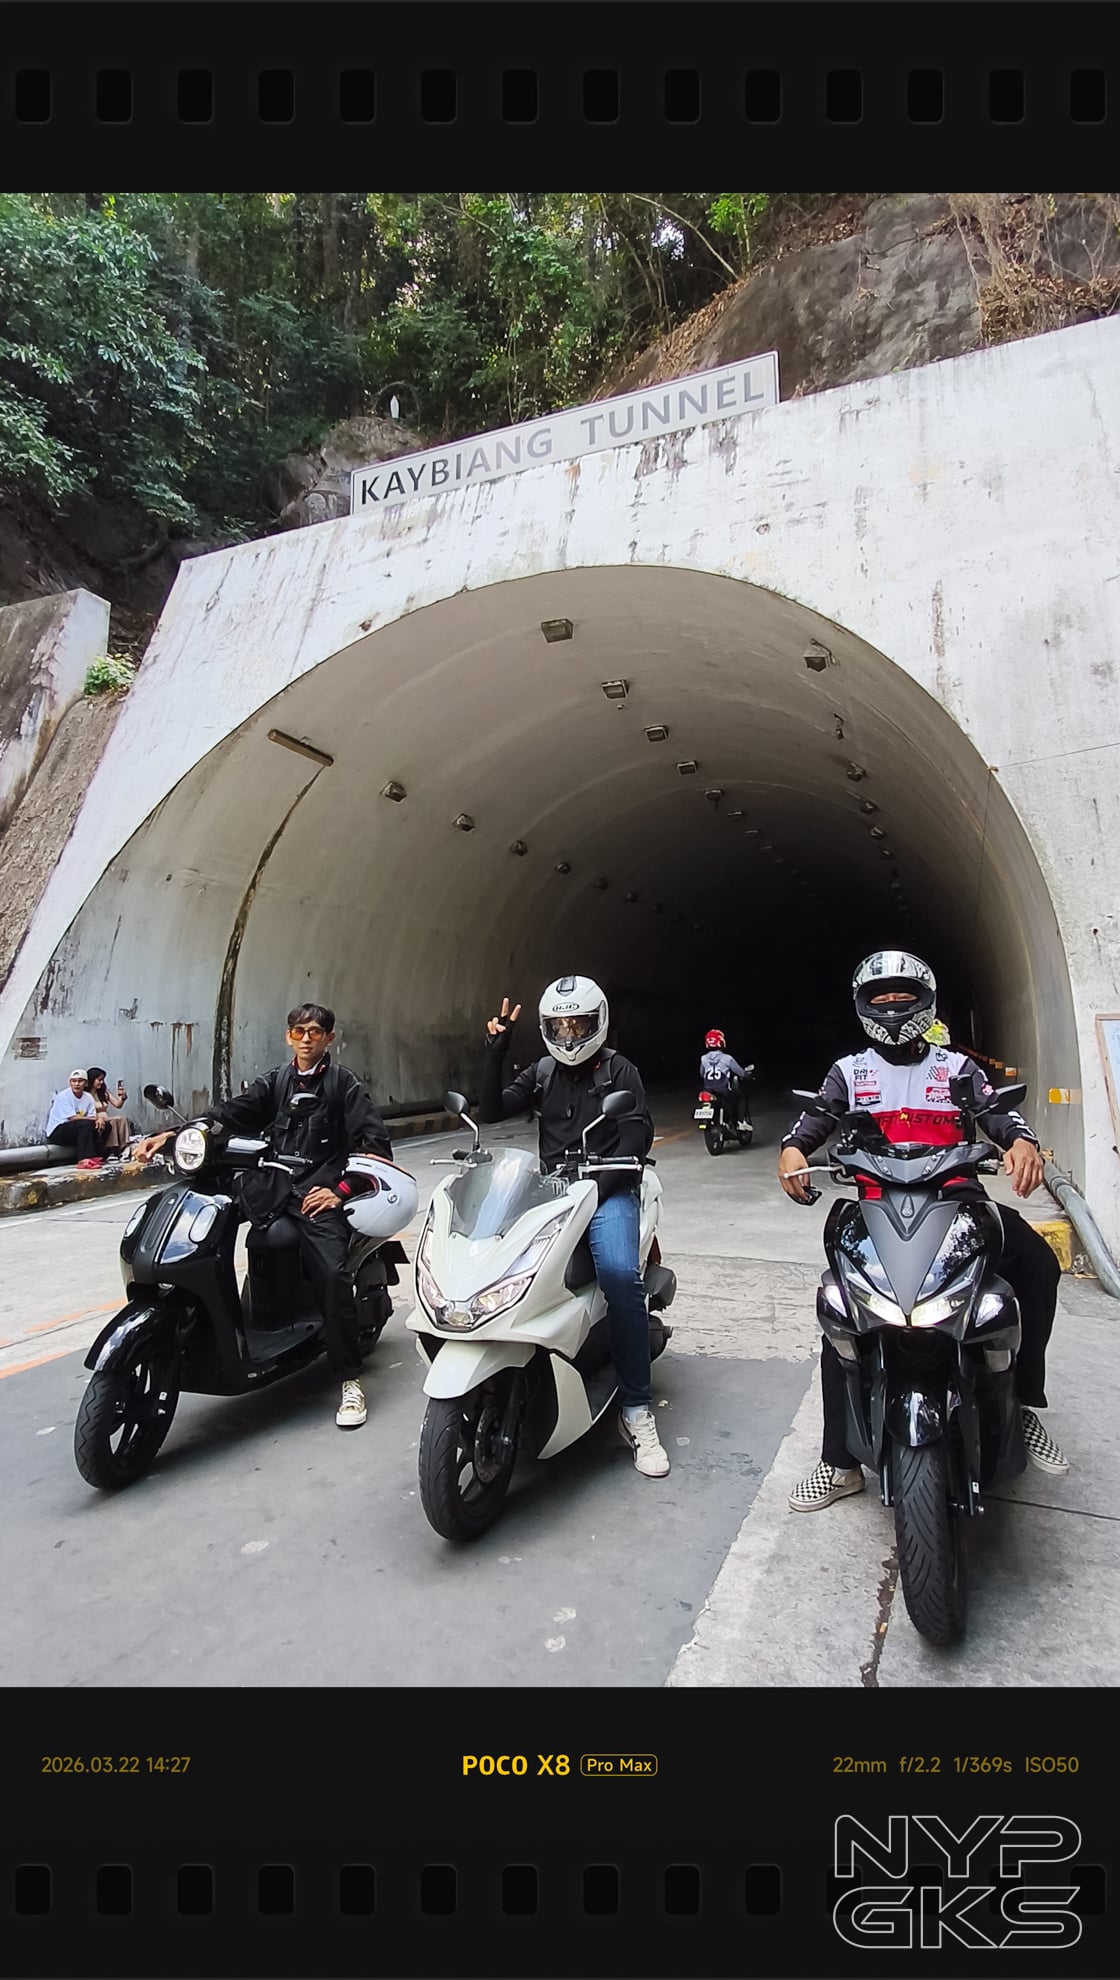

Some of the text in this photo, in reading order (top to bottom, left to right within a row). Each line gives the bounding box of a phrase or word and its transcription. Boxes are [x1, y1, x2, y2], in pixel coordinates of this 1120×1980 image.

[359, 371, 765, 506] KAYBIANG TUNNEL
[707, 1068, 722, 1080] 25
